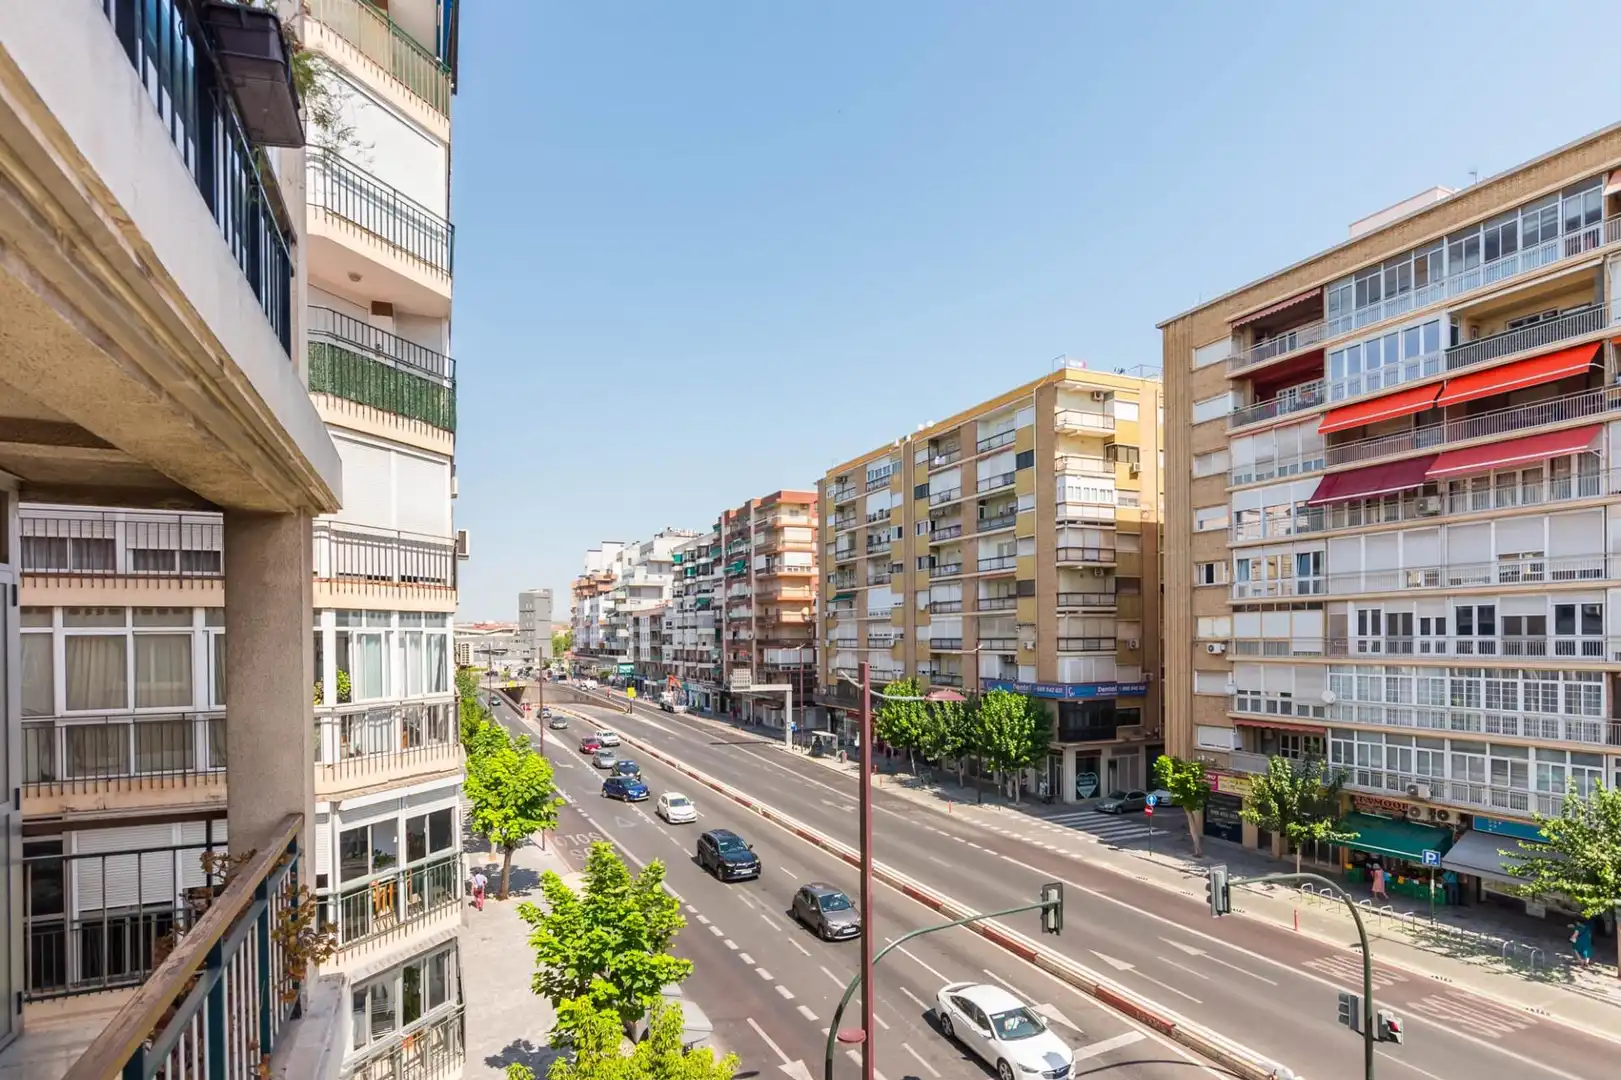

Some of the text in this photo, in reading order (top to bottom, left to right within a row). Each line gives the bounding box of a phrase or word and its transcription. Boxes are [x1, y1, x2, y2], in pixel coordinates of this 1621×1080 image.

[1097, 685, 1118, 693] Dental
[1425, 851, 1437, 864] P
[1406, 990, 1539, 1039] SOLO
